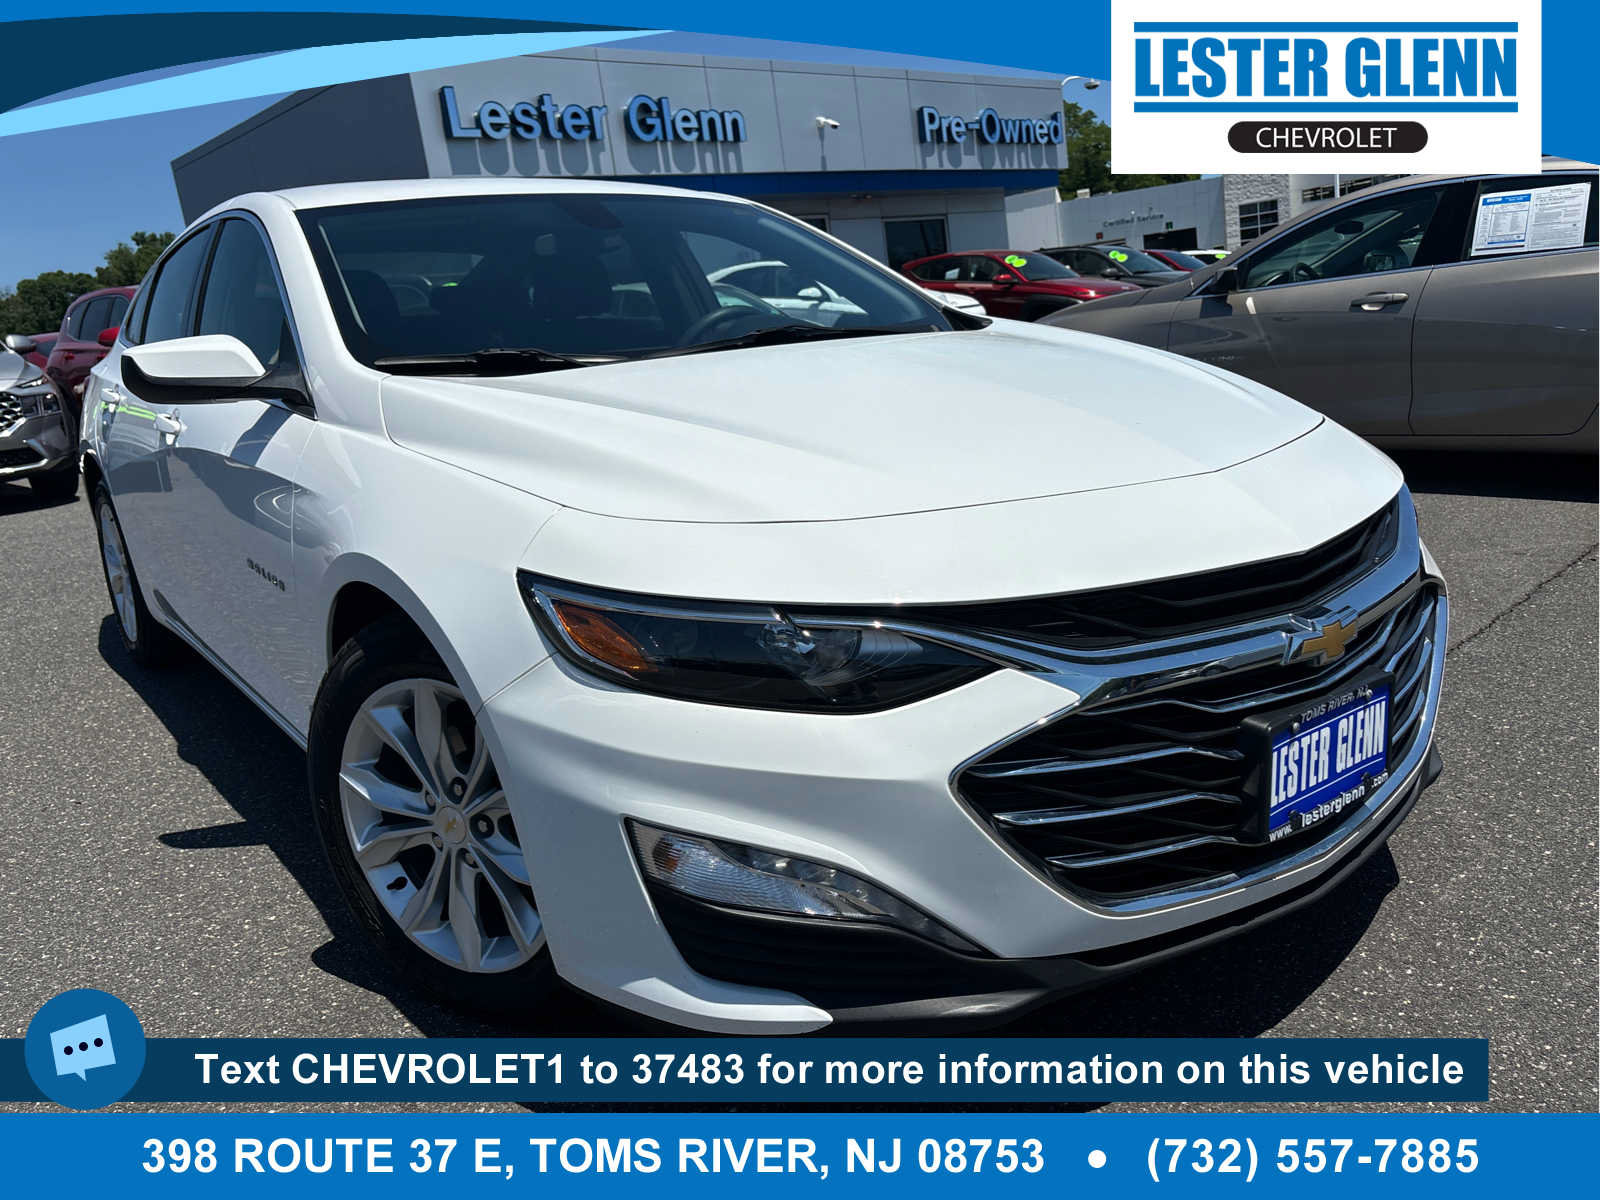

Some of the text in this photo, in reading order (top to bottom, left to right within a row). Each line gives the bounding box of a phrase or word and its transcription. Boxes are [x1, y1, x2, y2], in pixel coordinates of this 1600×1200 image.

[439, 86, 747, 143] Lester Glenn
[917, 106, 1064, 145] Pre-Owned
[1301, 704, 1326, 723] TOMS
[1270, 700, 1386, 808] LESTER GLENN
[1300, 784, 1365, 827] lesterglenn
